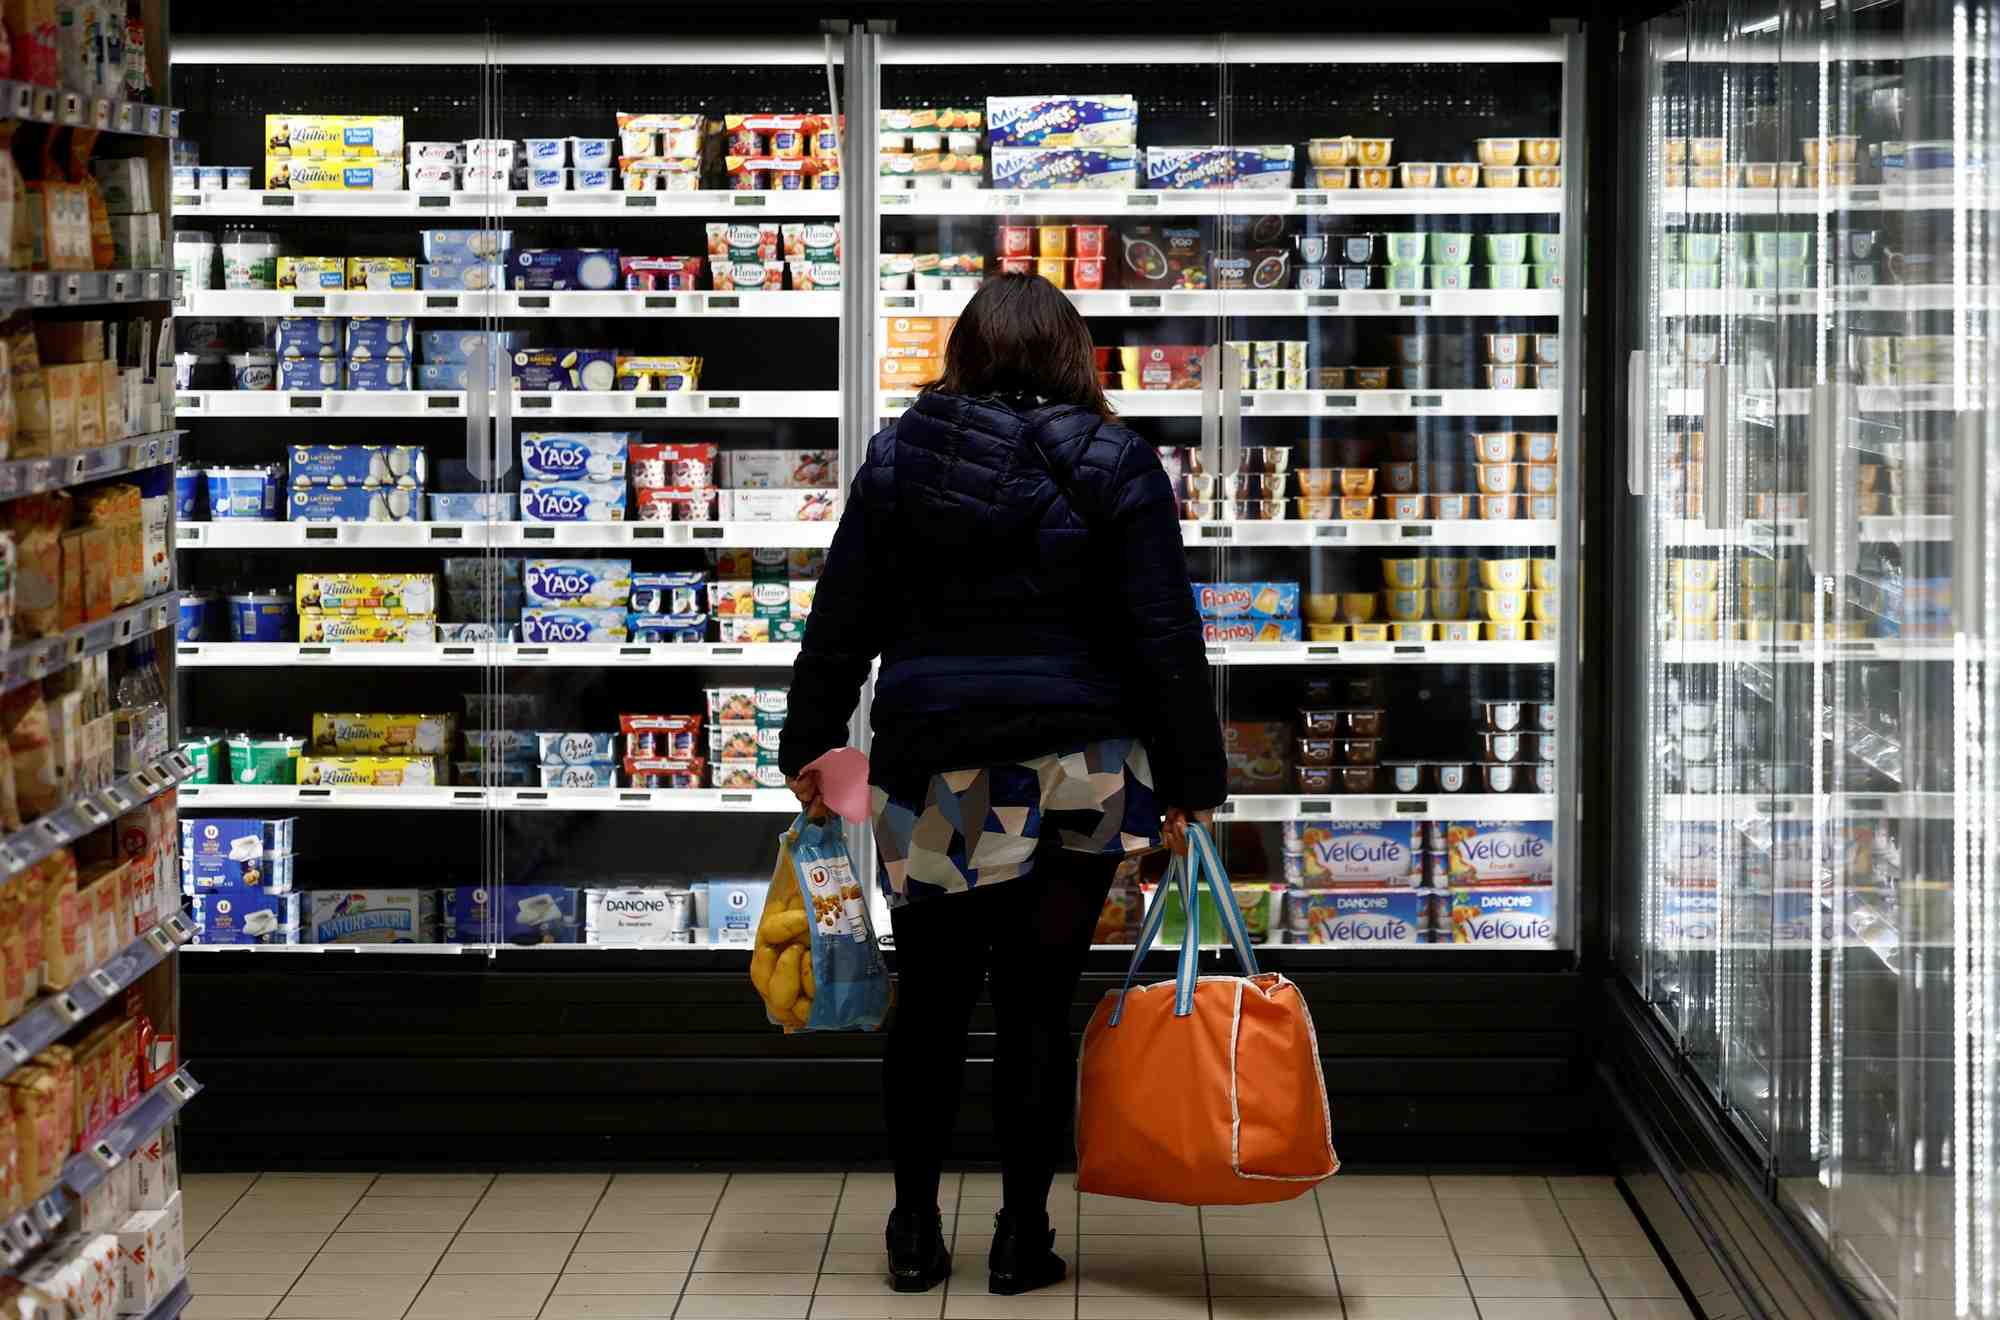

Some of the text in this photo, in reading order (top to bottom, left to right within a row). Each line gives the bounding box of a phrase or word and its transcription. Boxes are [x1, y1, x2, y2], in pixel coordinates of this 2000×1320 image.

[728, 224, 758, 241] Panier
[804, 224, 835, 240] Panier
[733, 262, 763, 278] Panier
[535, 445, 584, 467] YAOS
[535, 493, 583, 513] YAOS
[323, 581, 367, 596] Laitière
[540, 571, 590, 594] YAOS
[756, 584, 785, 598] Panier
[1200, 587, 1252, 611] Flanby
[325, 622, 370, 637] Laitière
[537, 620, 586, 641] YAOS
[1203, 623, 1256, 641] Flanby
[337, 725, 385, 741] Laitière
[321, 768, 370, 785] Laitière
[760, 766, 785, 780] Panie
[1317, 840, 1400, 862] Velouté
[1462, 838, 1544, 860] Velouté
[1320, 919, 1407, 941] Velouté
[1466, 919, 1552, 940] Velouté
